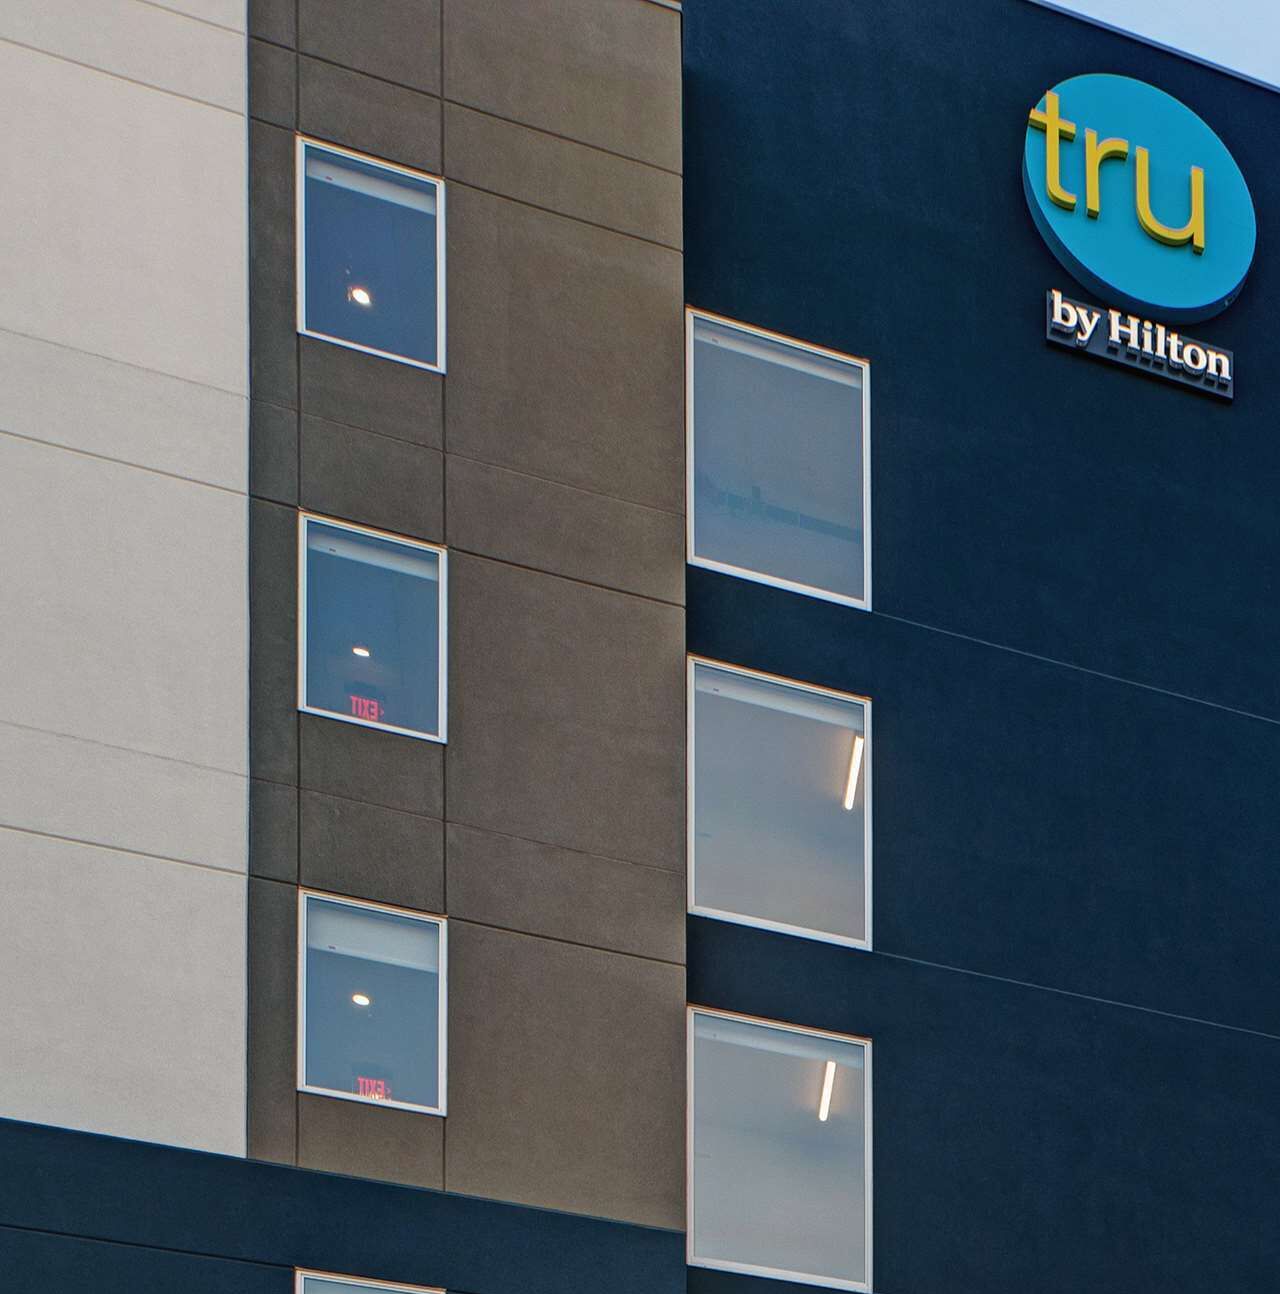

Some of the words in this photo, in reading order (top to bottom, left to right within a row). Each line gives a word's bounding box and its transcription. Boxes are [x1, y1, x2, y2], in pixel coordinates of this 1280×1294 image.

[1028, 90, 1205, 254] tru
[1051, 289, 1100, 344] by
[1108, 309, 1232, 382] Hilton
